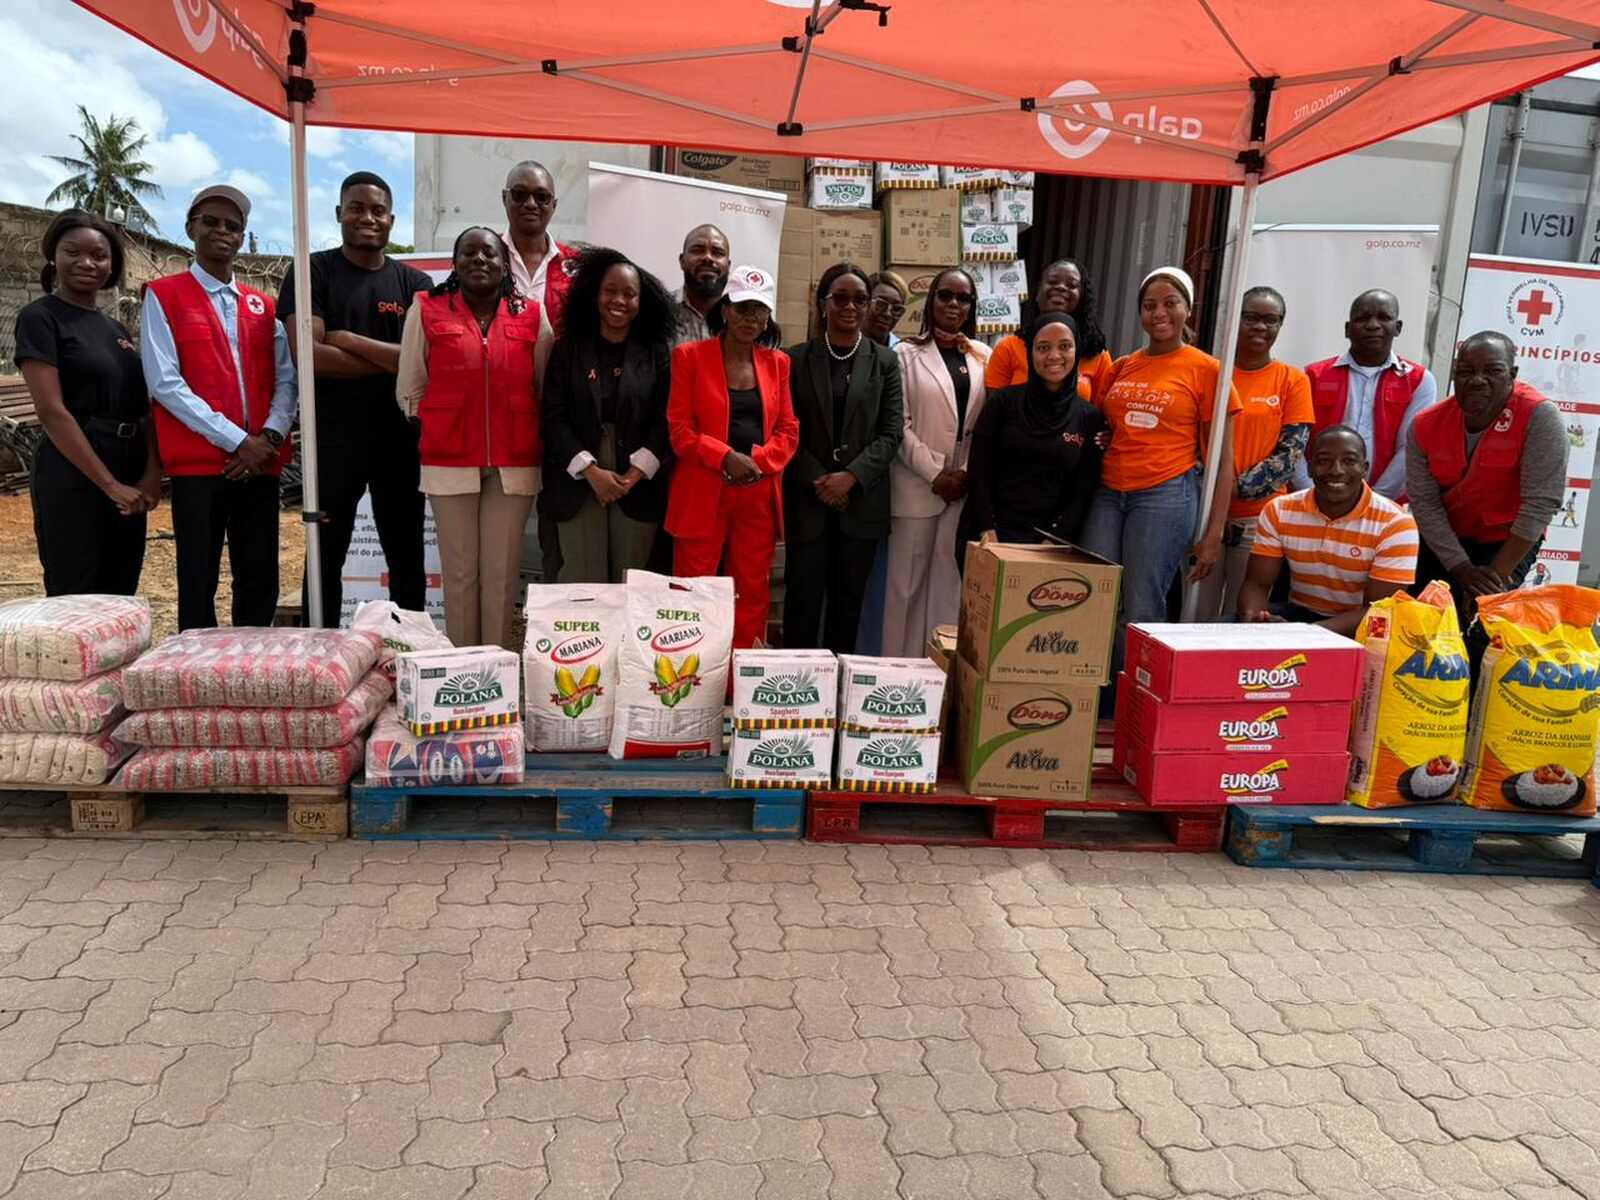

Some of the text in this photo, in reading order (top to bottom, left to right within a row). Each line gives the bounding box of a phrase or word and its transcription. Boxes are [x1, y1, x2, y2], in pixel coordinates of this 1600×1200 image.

[684, 152, 727, 167] Colgate
[1366, 238, 1422, 250] galp.co.mz
[1520, 327, 1545, 337] CVM
[656, 609, 701, 622] SUPER
[554, 621, 601, 632] SUPER
[659, 627, 702, 646] MARIANA
[559, 637, 602, 658] MARIANA
[1238, 668, 1298, 686] EUROPA
[439, 688, 499, 705] POLANA
[757, 692, 815, 704] POLANA
[769, 707, 800, 717] Spaghetti
[866, 700, 923, 714] POLANA
[1219, 719, 1279, 738] EUROPA
[752, 754, 811, 767] POLANA
[862, 753, 918, 767] POLANA
[1219, 773, 1279, 790] EUROPA
